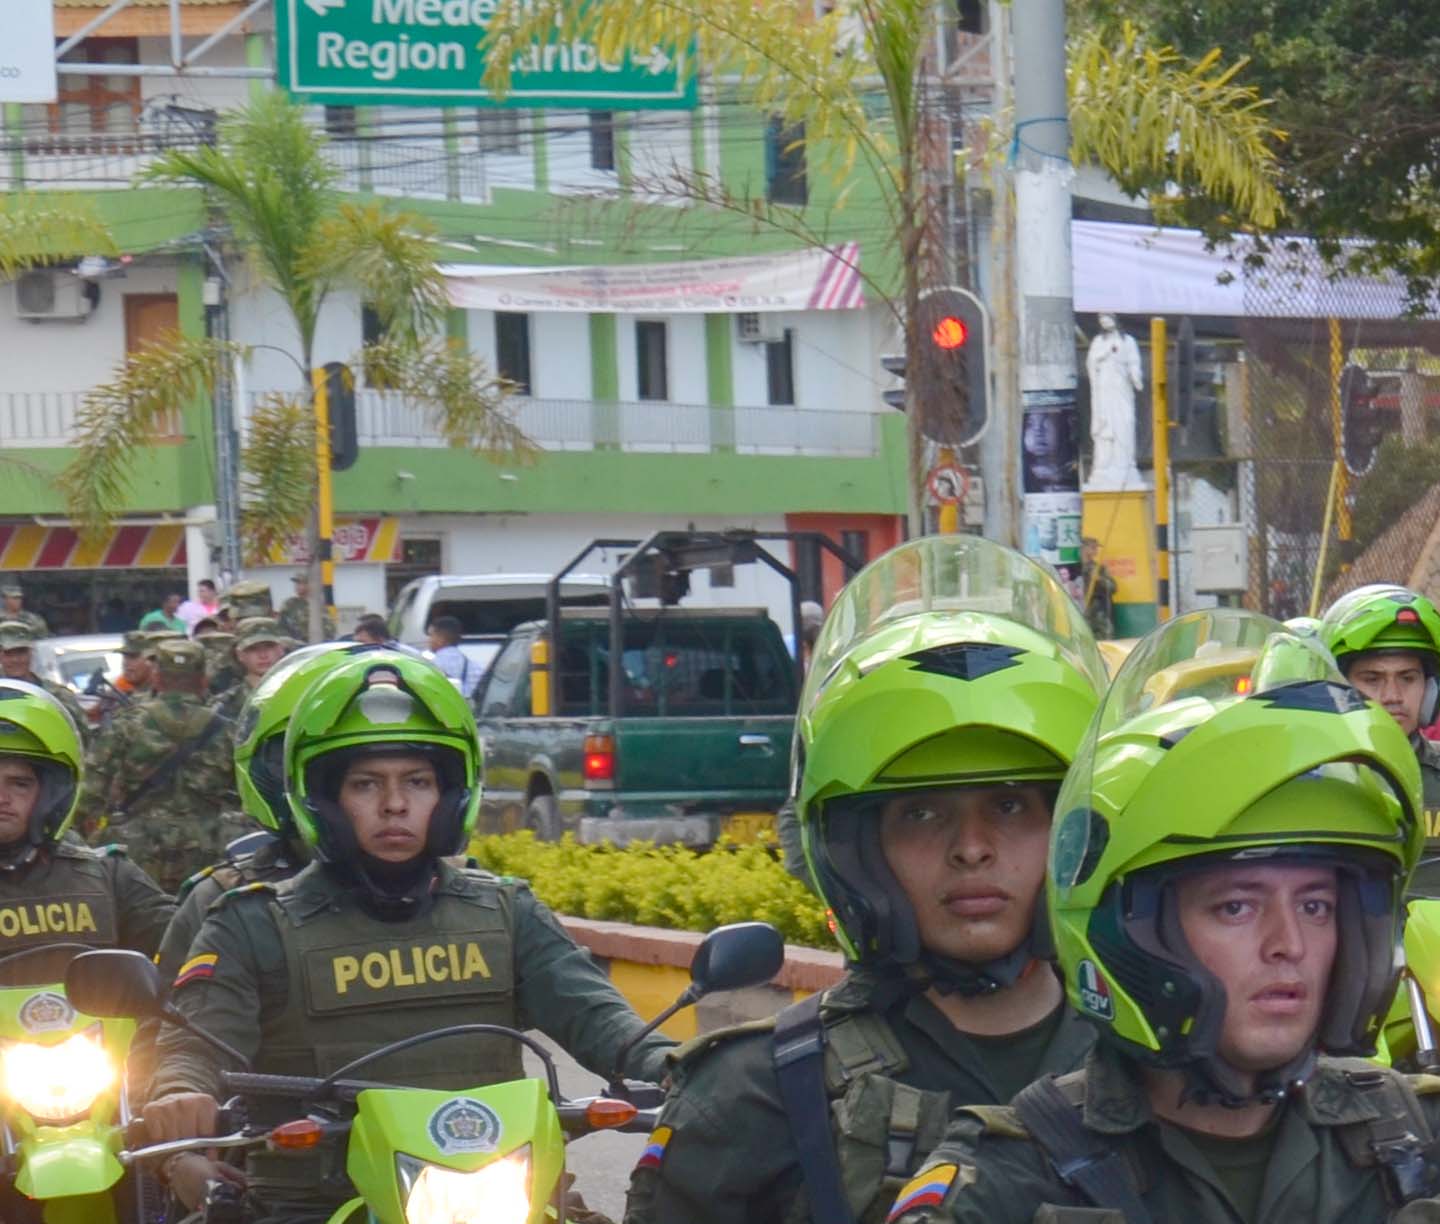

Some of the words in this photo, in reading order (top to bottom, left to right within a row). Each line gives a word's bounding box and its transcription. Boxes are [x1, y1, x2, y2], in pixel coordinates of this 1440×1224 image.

[316, 32, 465, 80] Region
[0, 902, 97, 937] OLICIA
[332, 942, 492, 994] POLICIA
